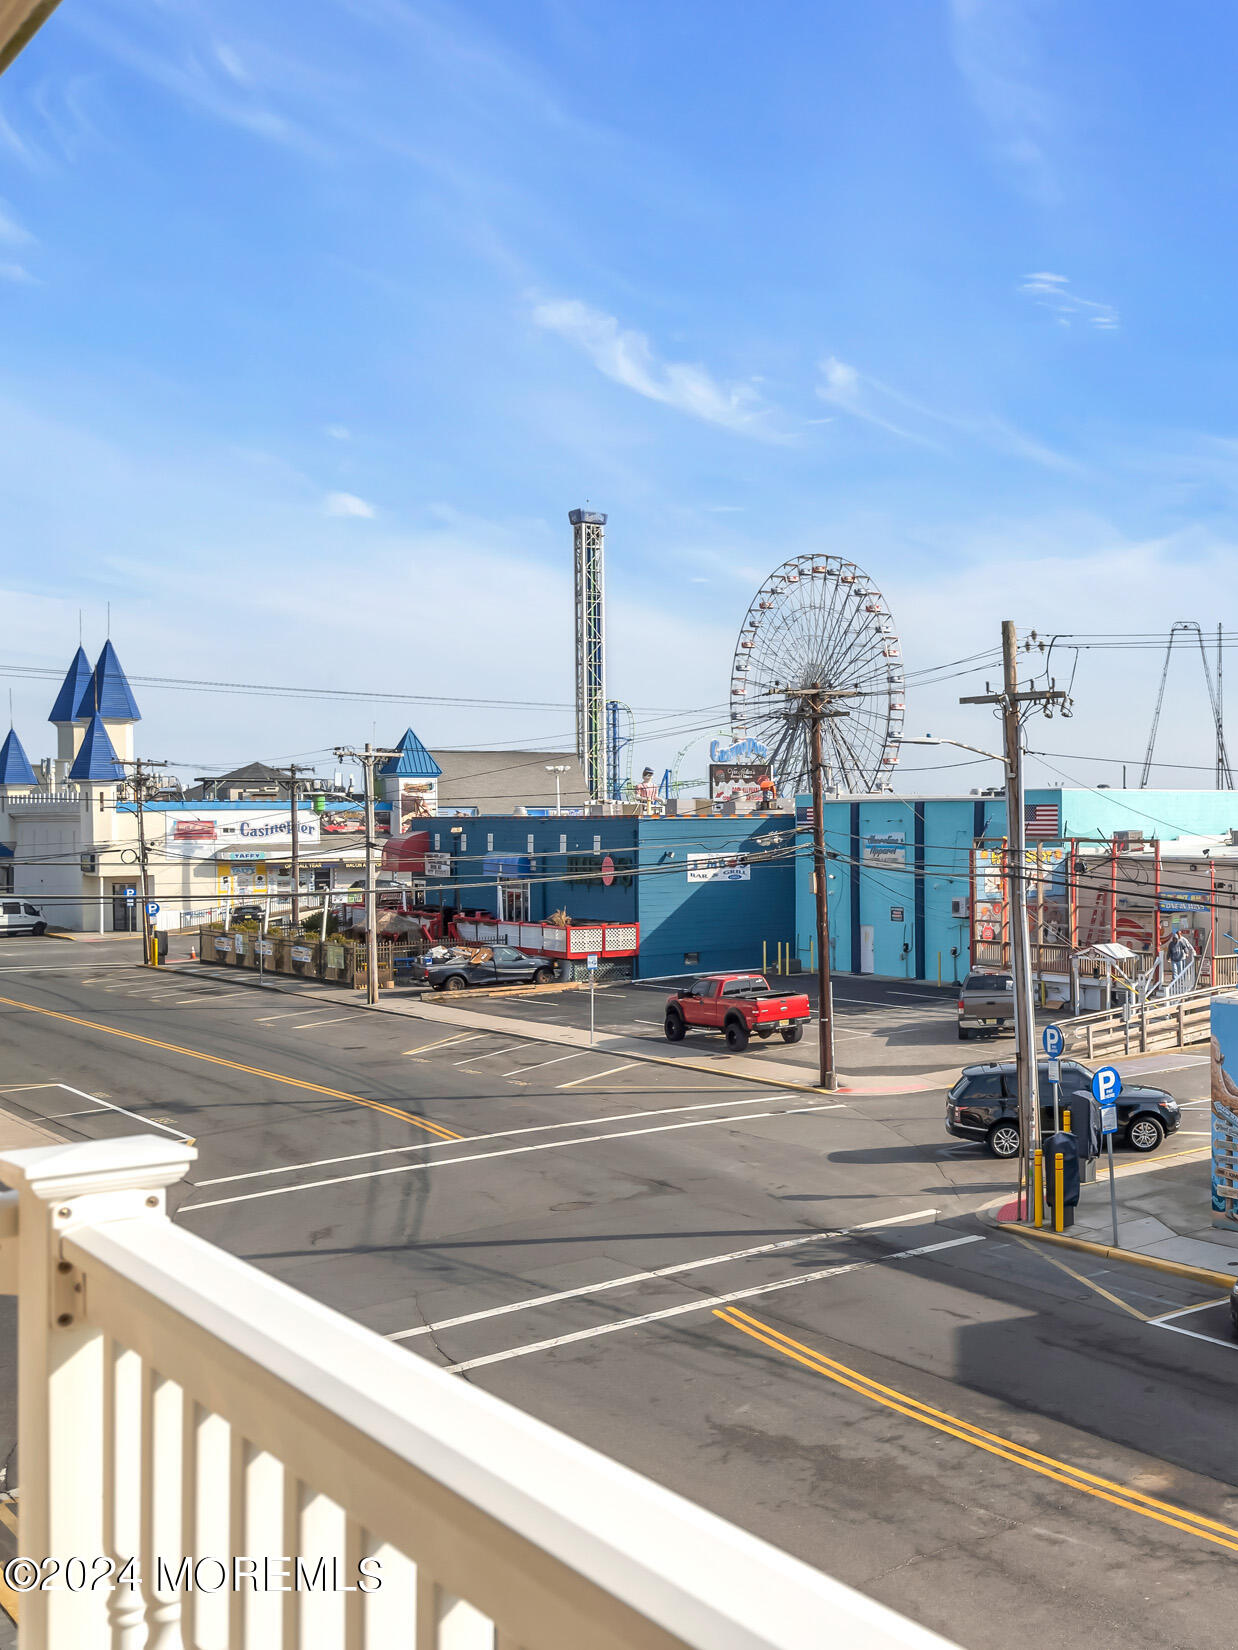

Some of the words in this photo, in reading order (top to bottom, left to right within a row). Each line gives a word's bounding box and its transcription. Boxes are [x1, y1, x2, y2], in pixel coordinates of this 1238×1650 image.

[240, 822, 286, 837] Casino
[1046, 1028, 1059, 1053] P
[1098, 1070, 1116, 1101] P
